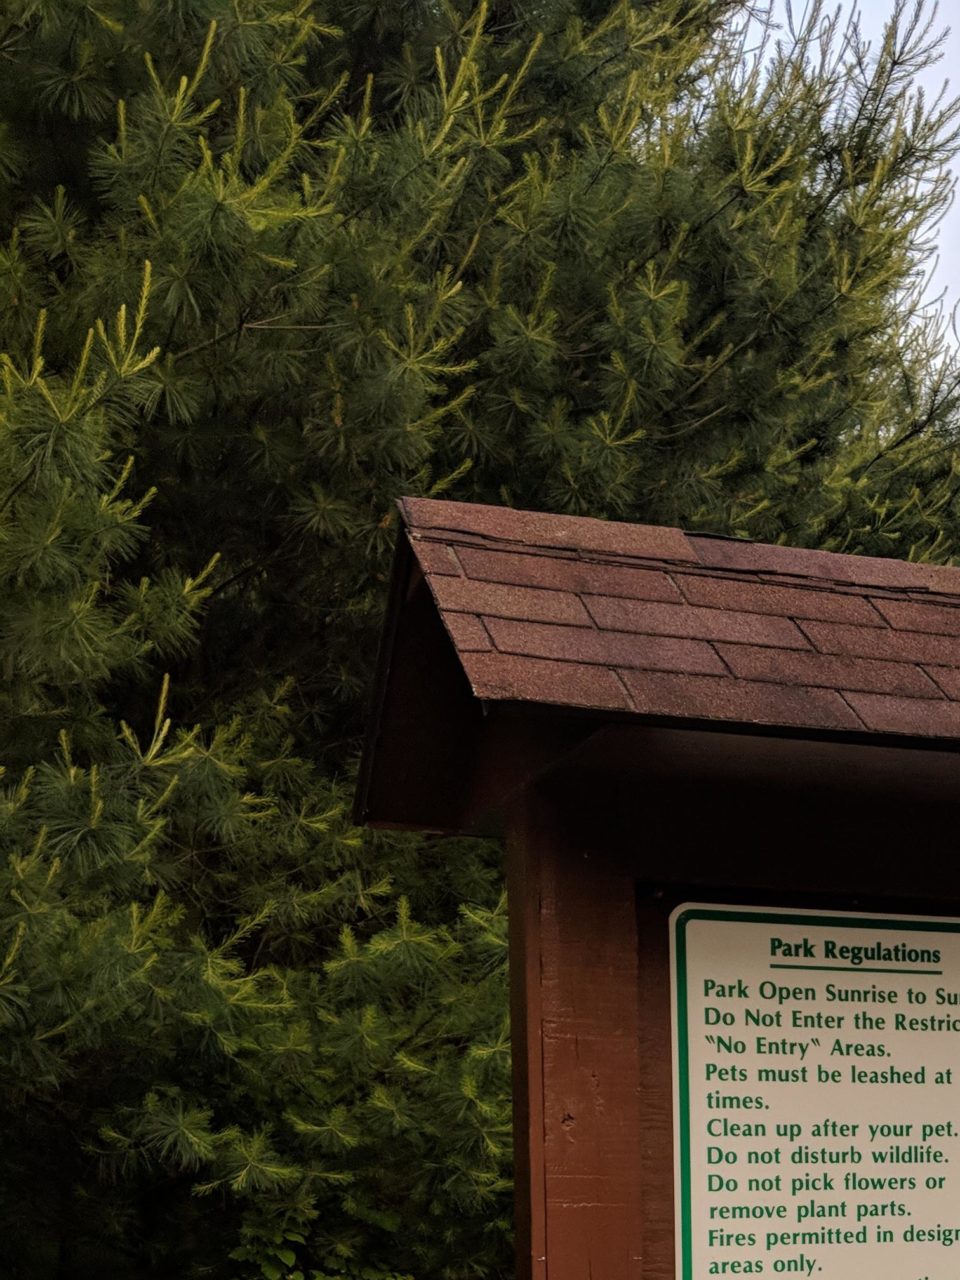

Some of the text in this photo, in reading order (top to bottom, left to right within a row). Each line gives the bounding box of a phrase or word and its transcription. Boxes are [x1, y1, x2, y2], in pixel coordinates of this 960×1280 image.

[770, 938, 941, 966] Park Regulations
[704, 979, 749, 998] Park
[759, 981, 816, 1005] Open
[826, 984, 898, 1004] Sunrise
[907, 988, 927, 1004] to
[705, 1007, 735, 1026] Do
[745, 1009, 782, 1027] Not
[792, 1010, 845, 1029] Enter
[854, 1011, 886, 1030] the
[830, 1039, 891, 1057] Areas.
[706, 1063, 747, 1082] Pets
[758, 1066, 808, 1083] must
[817, 1064, 842, 1083] be
[851, 1065, 925, 1084] leashed
[935, 1069, 952, 1084] at
[706, 1090, 769, 1110] times.
[707, 1118, 958, 1142] Clean up after your pet.
[707, 1145, 948, 1164] Do not disturb wildlife.
[708, 1172, 946, 1196] Do not pick flowers or
[710, 1200, 911, 1223] remove plant parts.
[709, 1228, 756, 1247] Fires
[766, 1225, 867, 1251] permitted
[877, 1225, 893, 1243] in
[709, 1254, 822, 1277] areas only.
